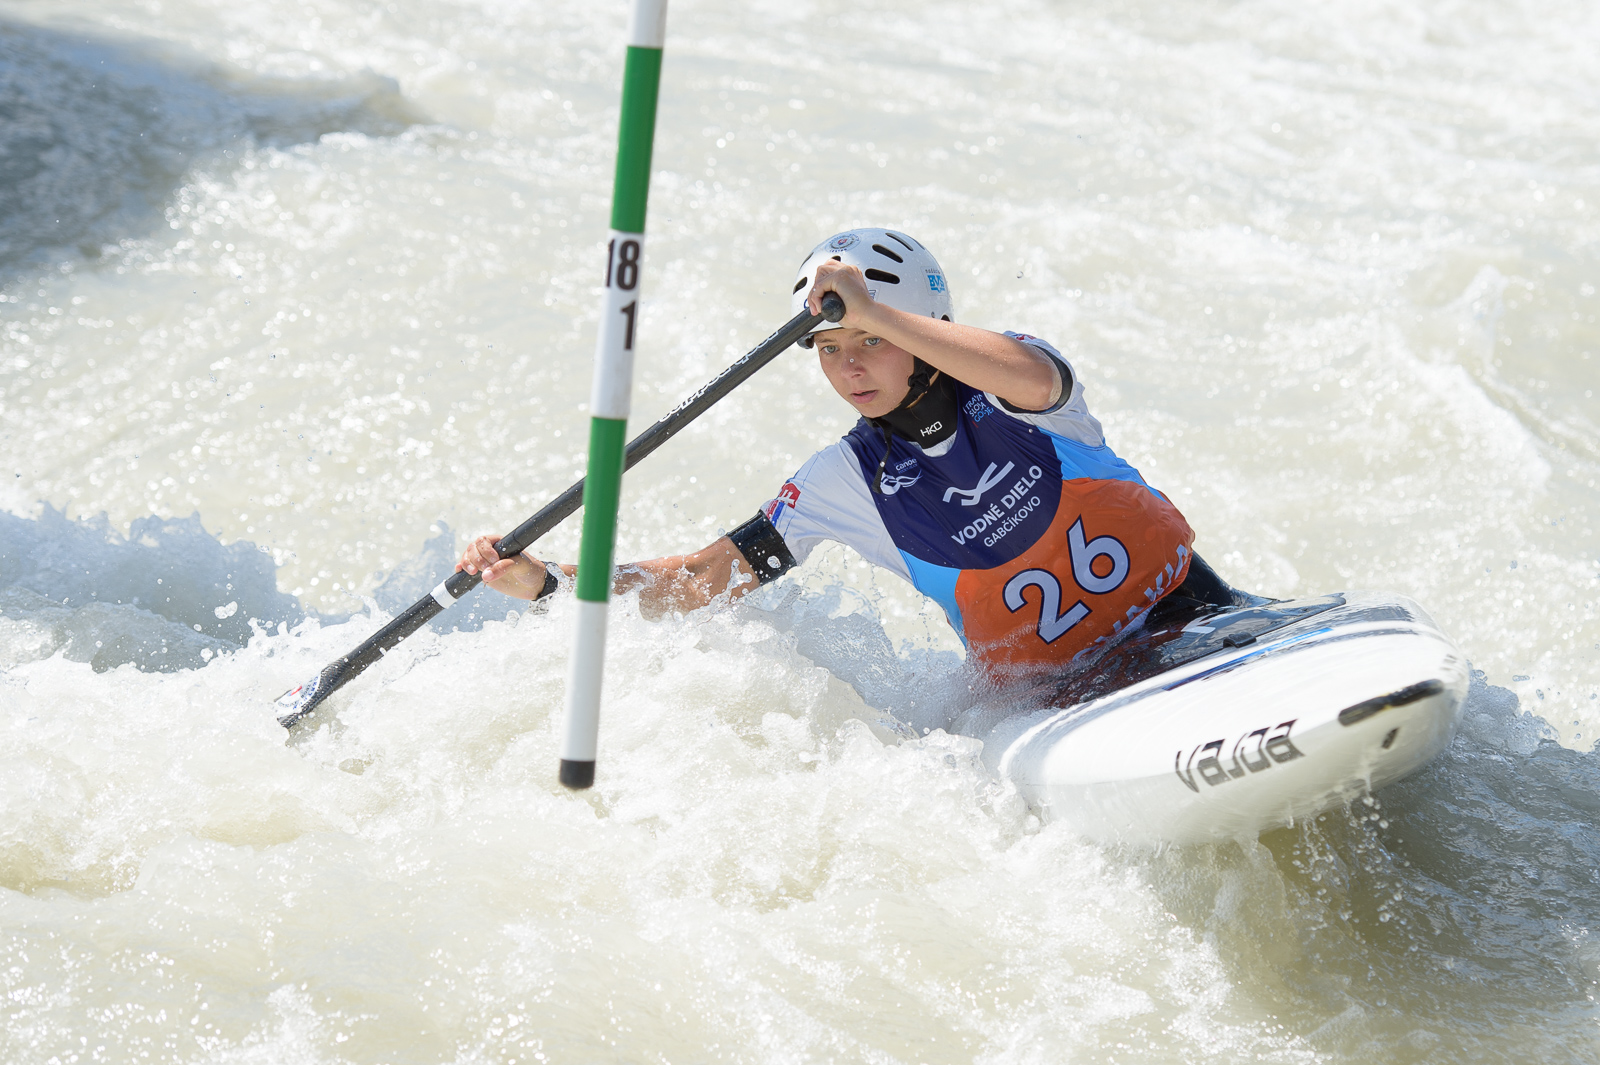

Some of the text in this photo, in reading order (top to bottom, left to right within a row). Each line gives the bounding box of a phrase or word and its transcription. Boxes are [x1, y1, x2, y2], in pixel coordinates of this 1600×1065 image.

[606, 239, 640, 291] 18
[620, 300, 637, 350] 1
[895, 458, 918, 471] canoe
[951, 465, 1043, 545] VODNÉ DIELO
[983, 496, 1041, 547] GABČÍKOVO
[1002, 514, 1131, 645] 26
